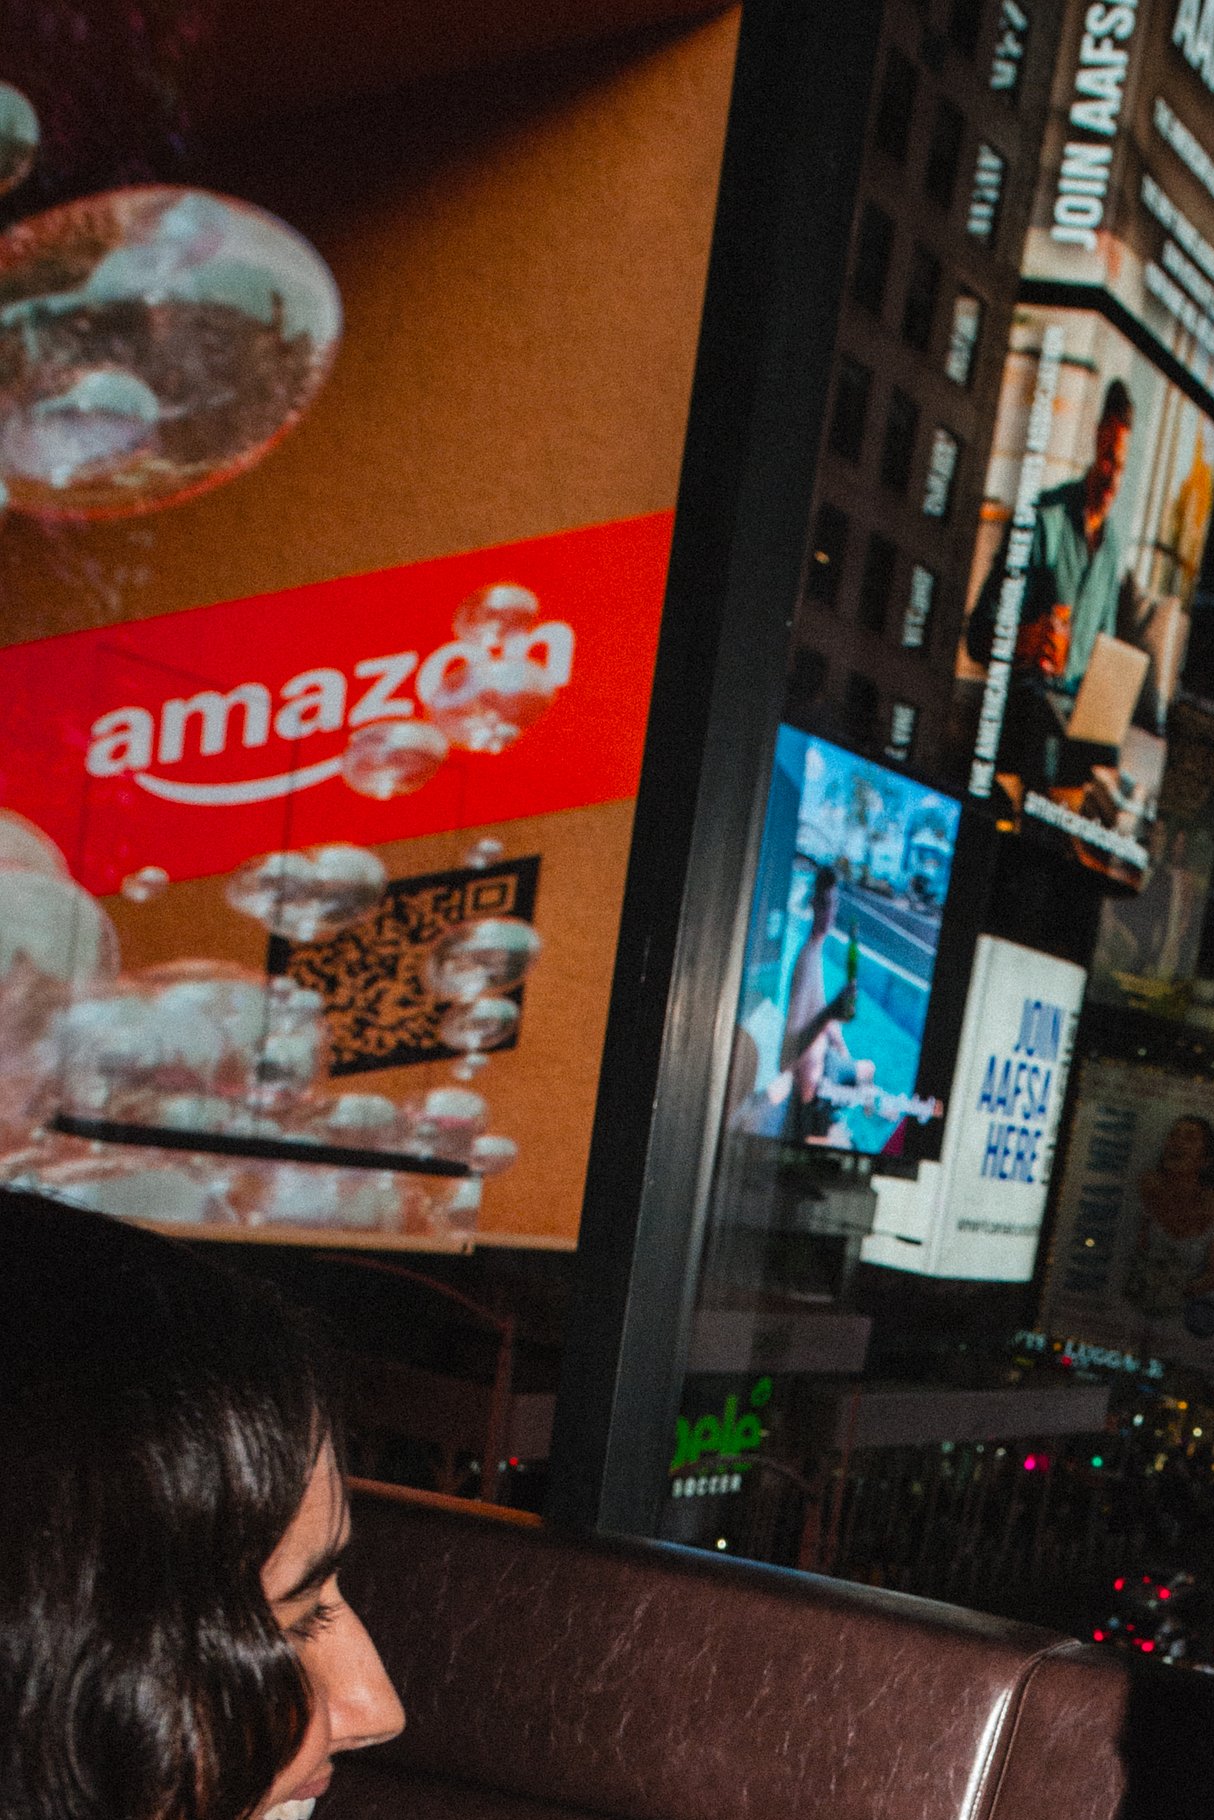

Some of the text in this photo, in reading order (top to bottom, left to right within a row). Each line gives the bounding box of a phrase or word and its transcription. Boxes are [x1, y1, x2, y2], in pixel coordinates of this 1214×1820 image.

[1052, 0, 1139, 251] JOIN AAFS
[1014, 998, 1062, 1062] JOIN
[977, 1055, 1051, 1123] AAFSA
[981, 1121, 1041, 1184] HERE
